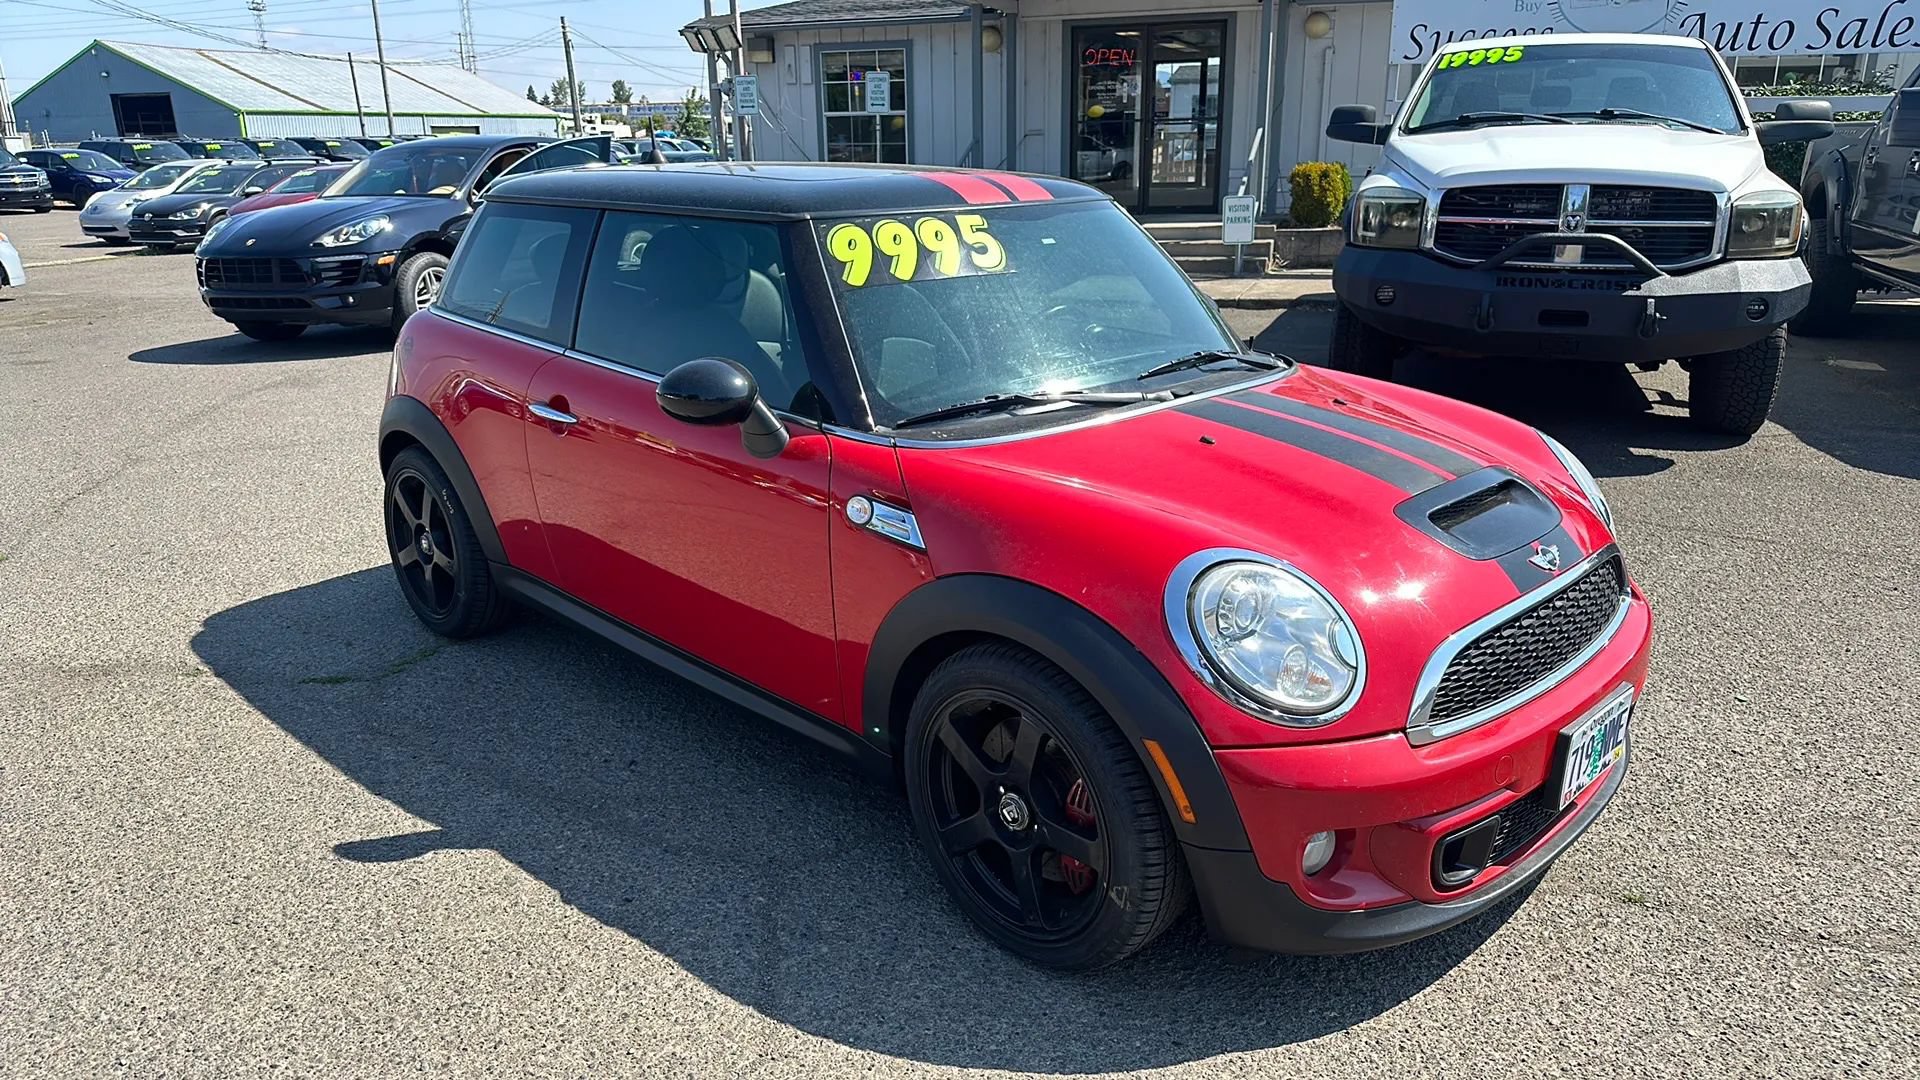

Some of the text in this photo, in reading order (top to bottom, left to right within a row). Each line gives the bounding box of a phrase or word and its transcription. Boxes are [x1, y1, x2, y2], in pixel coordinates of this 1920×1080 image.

[1514, 0, 1541, 15] Buy
[1679, 0, 1920, 52] Auto Sale
[1085, 48, 1135, 67] OPEN
[1437, 45, 1525, 70] 19995
[1228, 204, 1250, 213] VISITOR
[1226, 215, 1252, 225] PARKING
[826, 214, 1007, 288] 9995
[1495, 276, 1643, 292] IRON CROSS
[1568, 734, 1596, 789] 719
